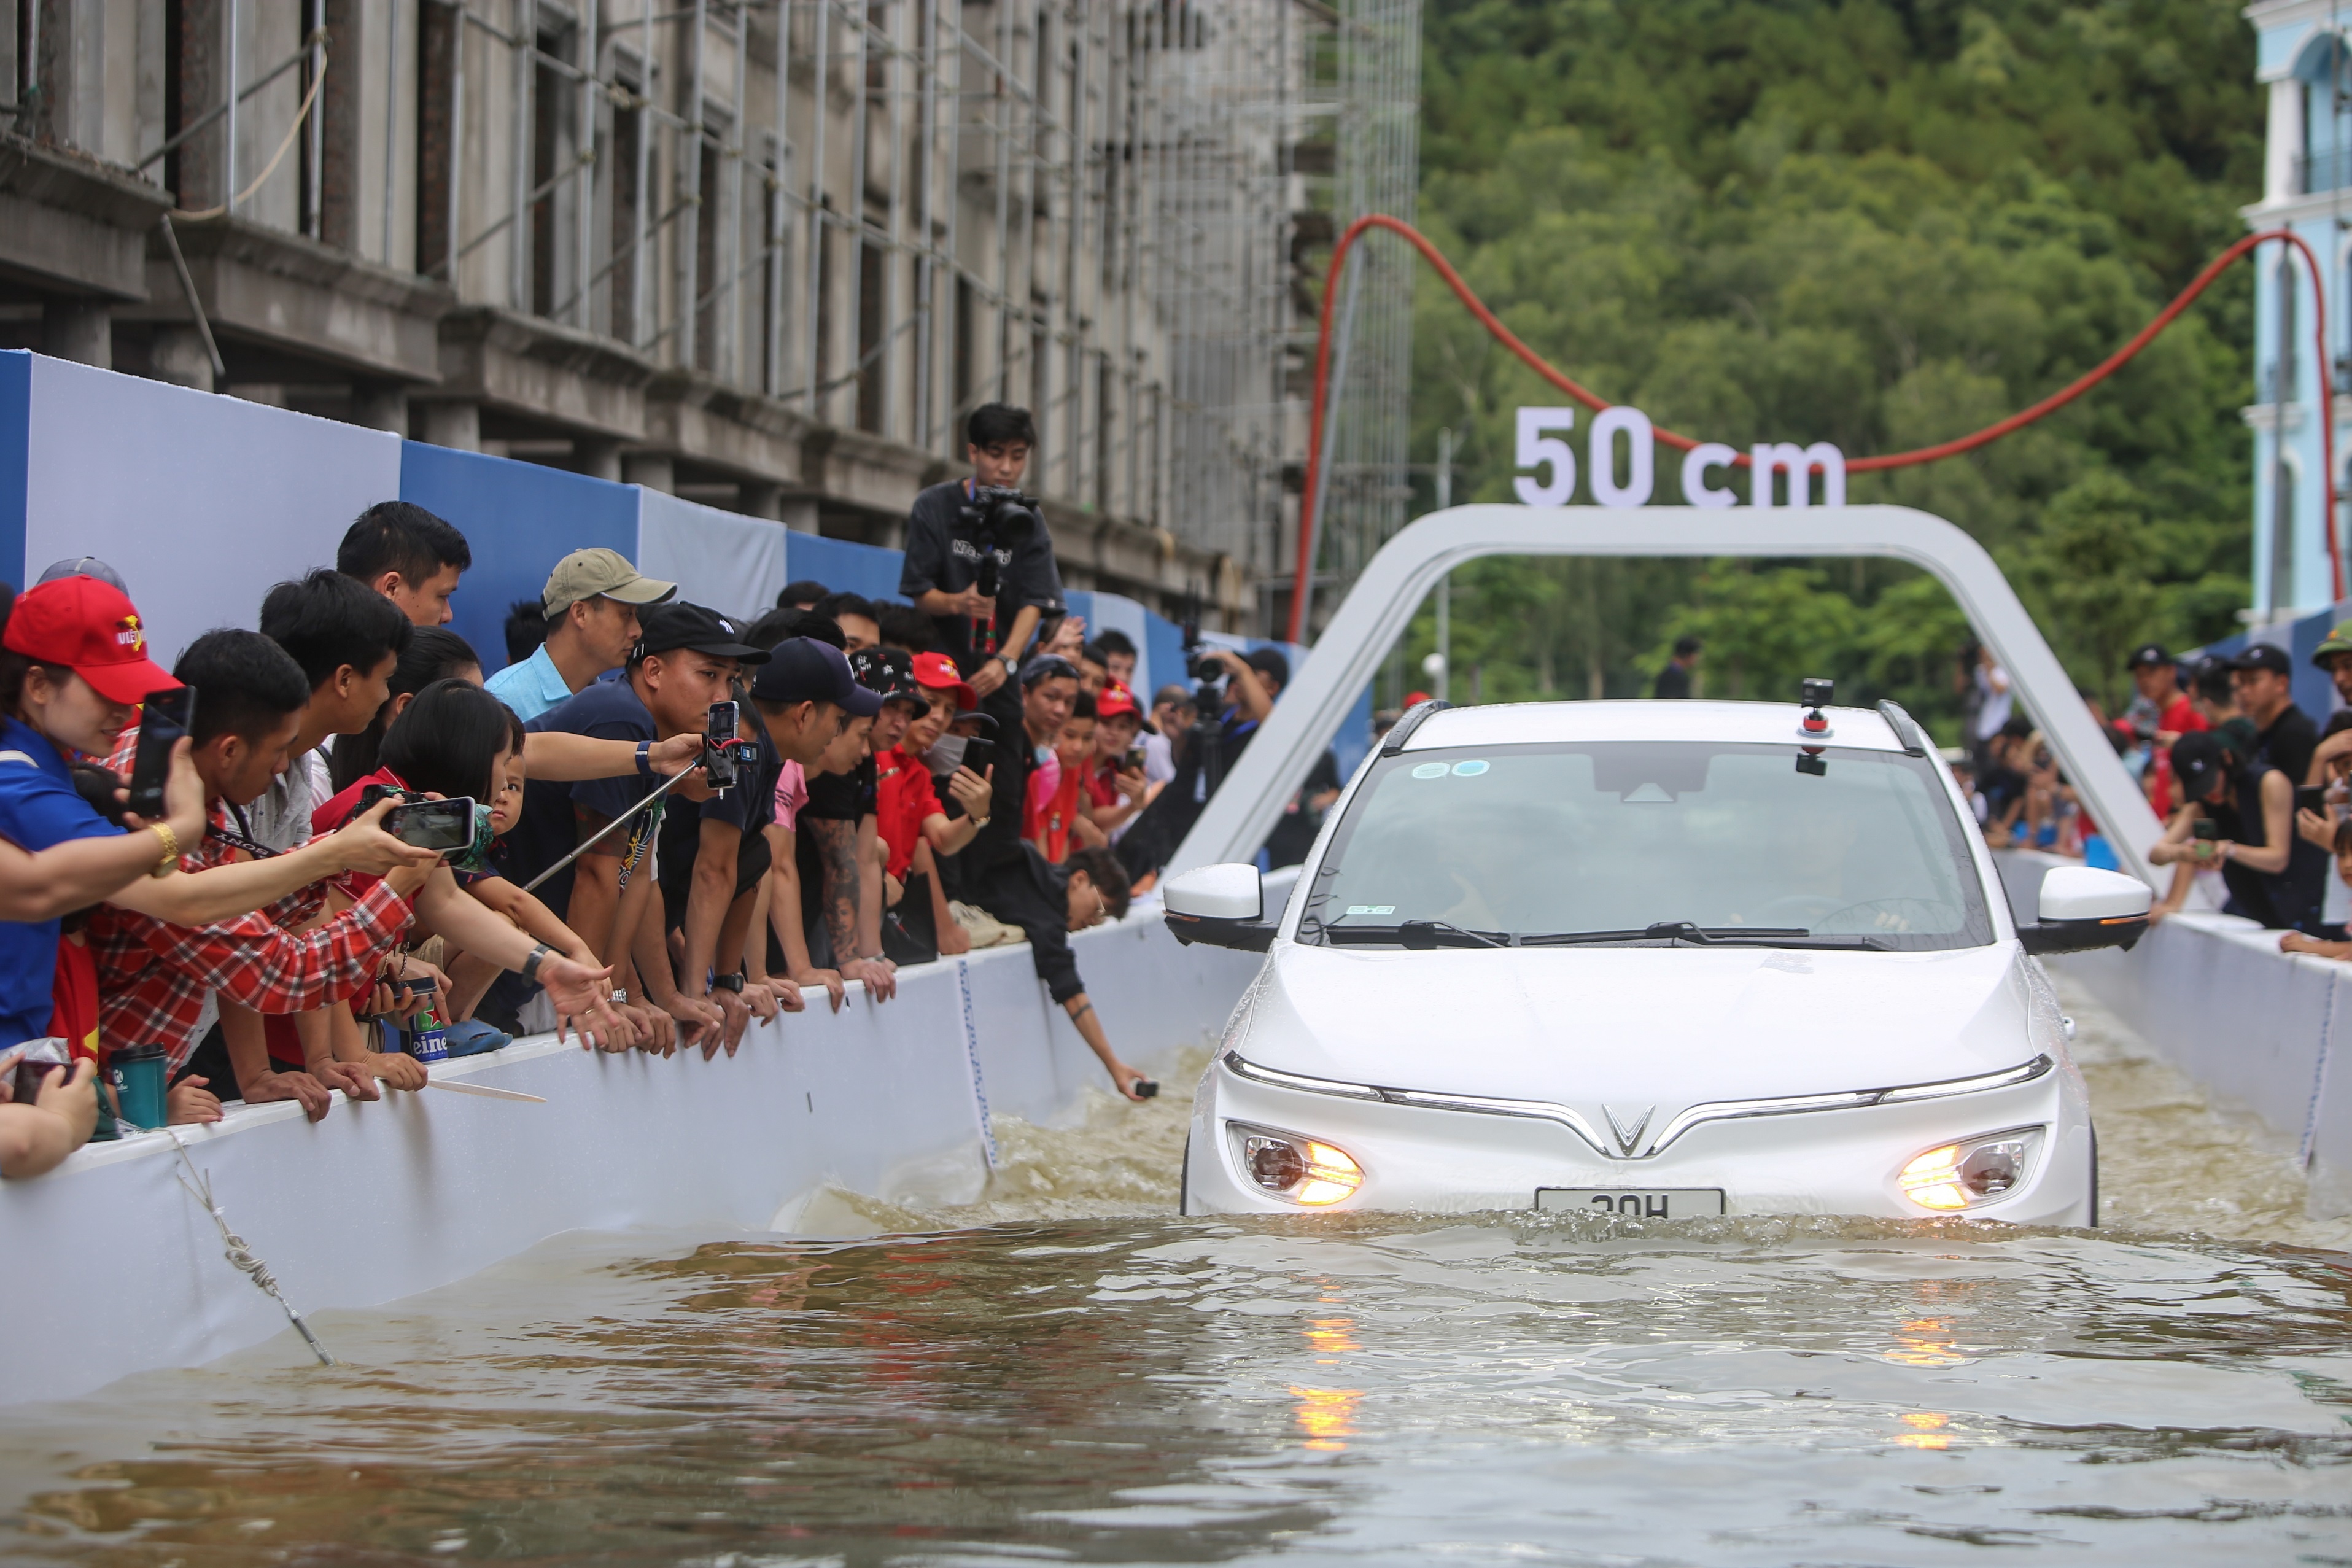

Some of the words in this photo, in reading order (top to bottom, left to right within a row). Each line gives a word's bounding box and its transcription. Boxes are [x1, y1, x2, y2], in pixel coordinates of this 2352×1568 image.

[1513, 406, 1655, 506] 50
[1681, 442, 1847, 506] cm
[215, 833, 269, 855] SONY
